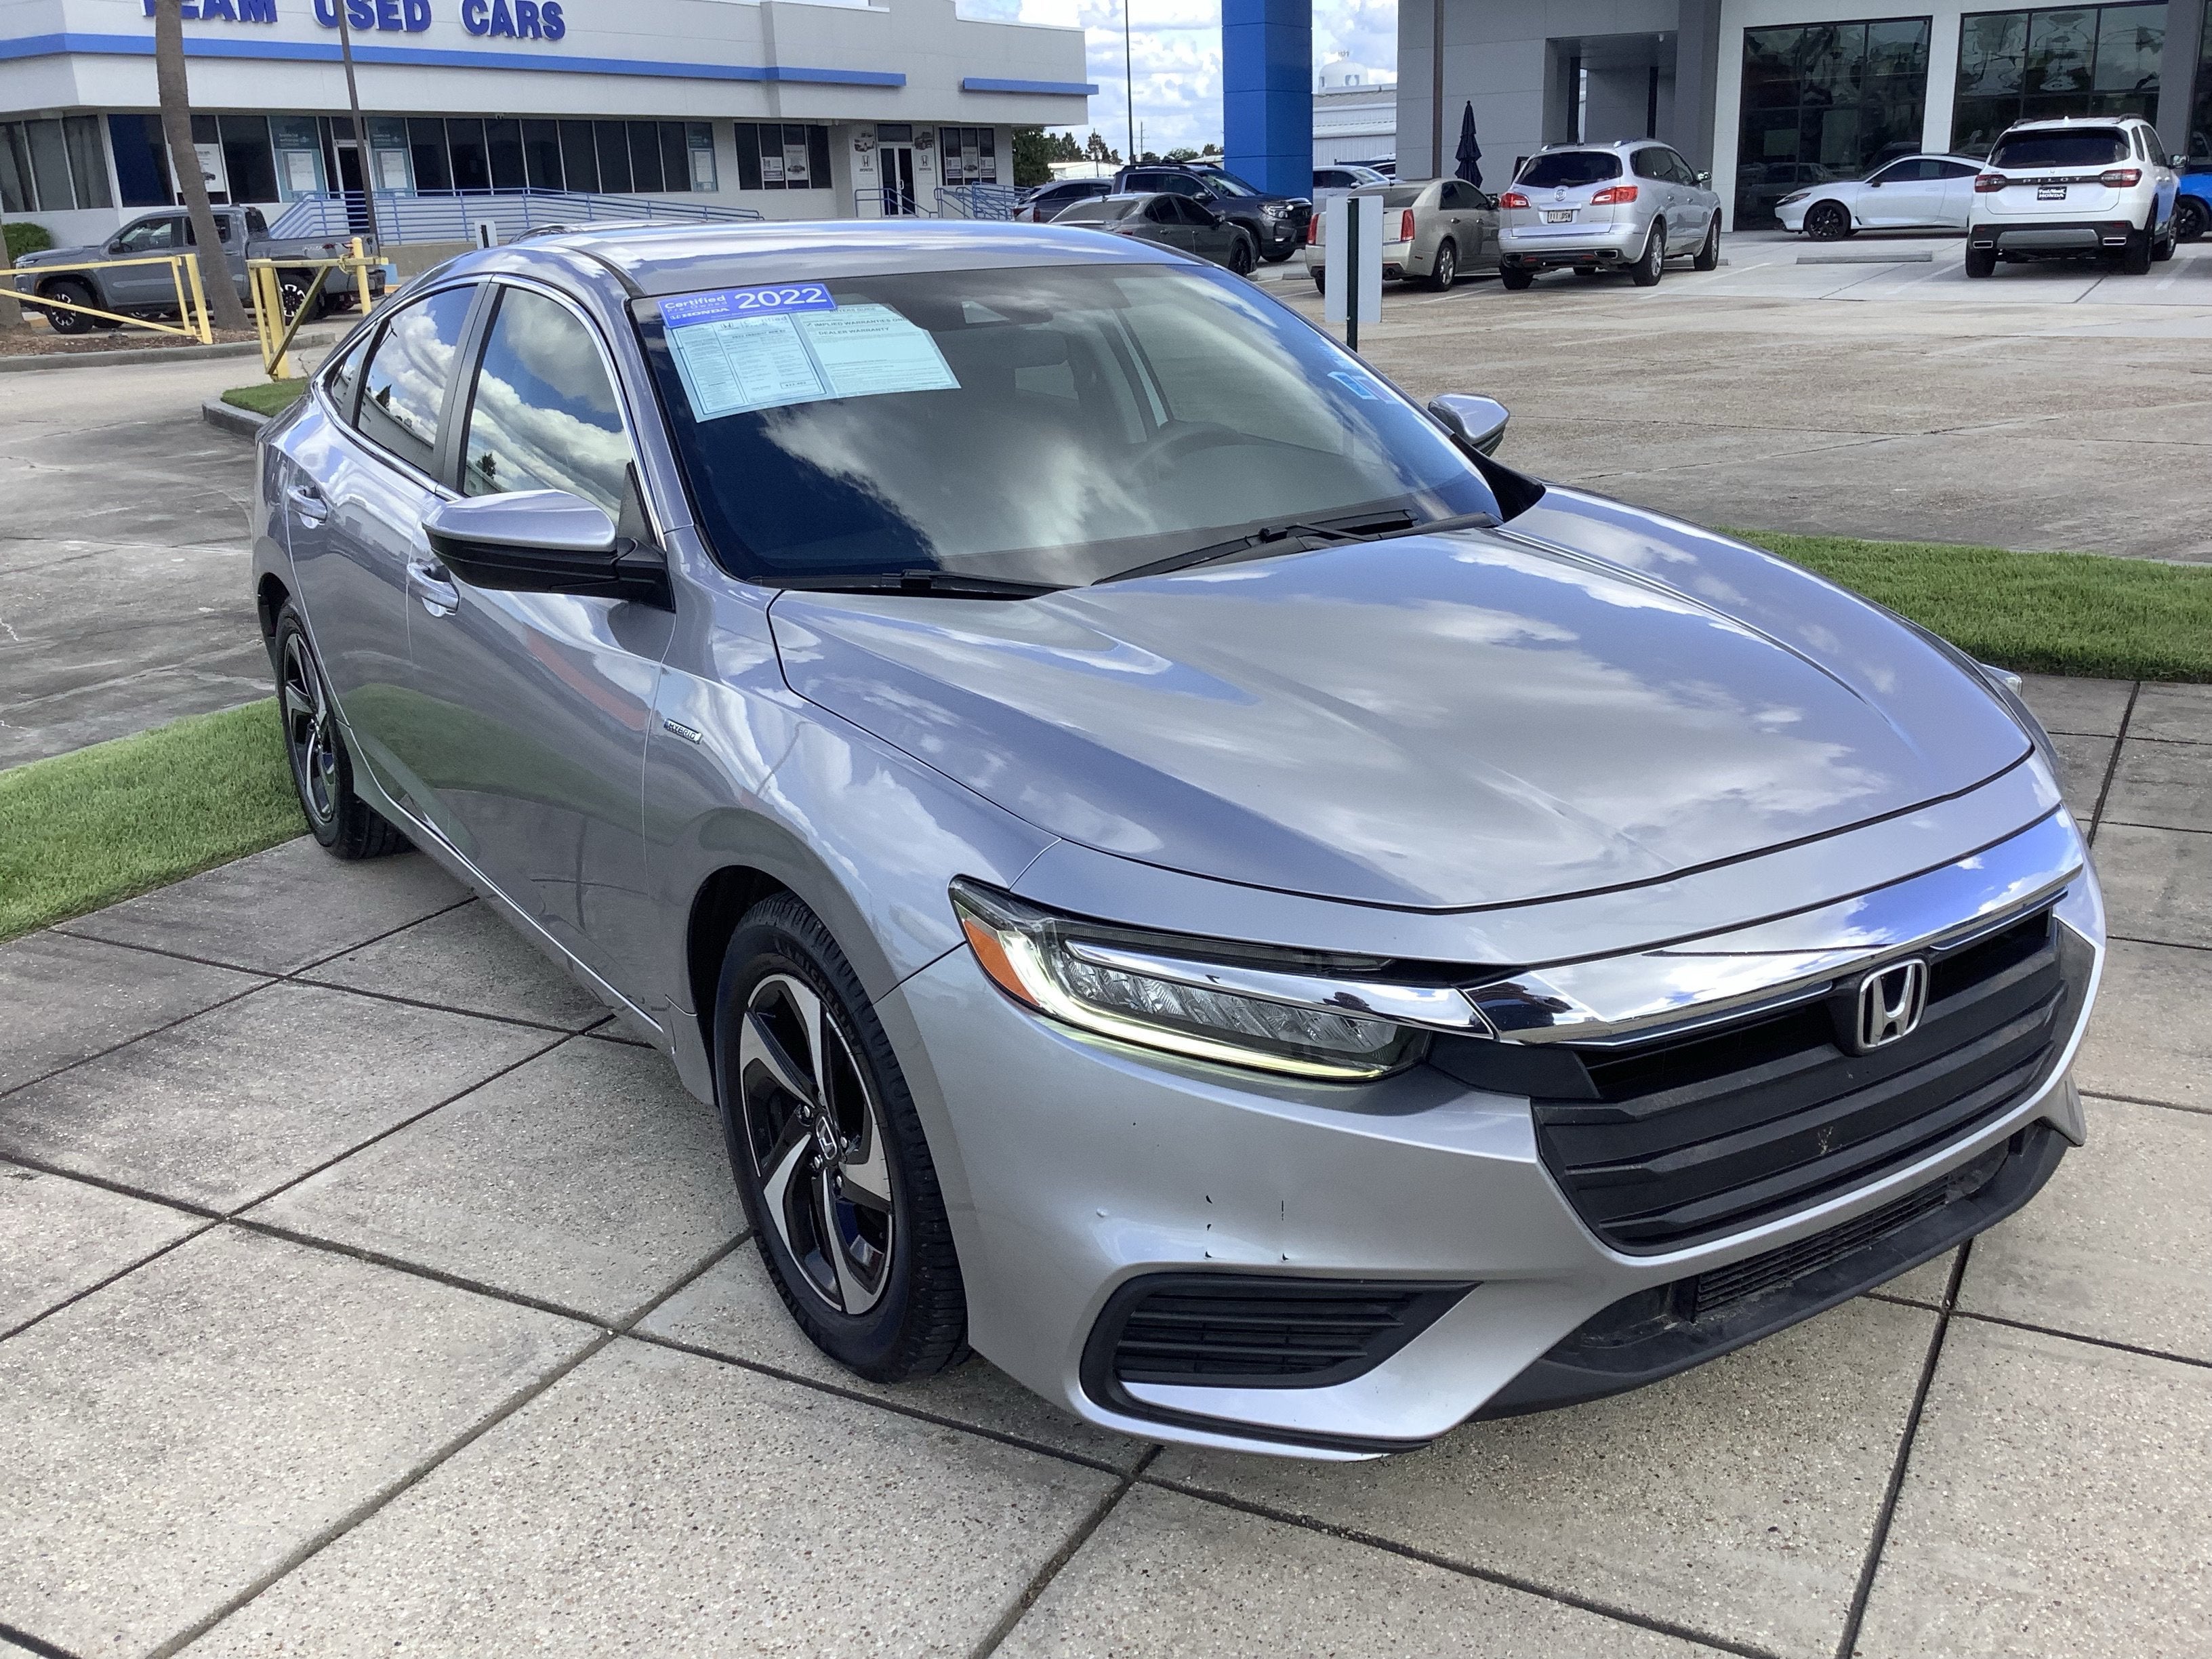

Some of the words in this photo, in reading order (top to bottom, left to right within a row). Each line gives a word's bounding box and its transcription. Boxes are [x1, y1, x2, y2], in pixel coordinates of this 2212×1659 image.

[312, 0, 432, 33] USED
[462, 0, 566, 41] CARS
[664, 294, 726, 310] Certified
[734, 287, 827, 310] 2022
[682, 307, 731, 319] HONDA
[844, 318, 890, 326] WARRANTIES
[668, 722, 696, 739] HYBRID
